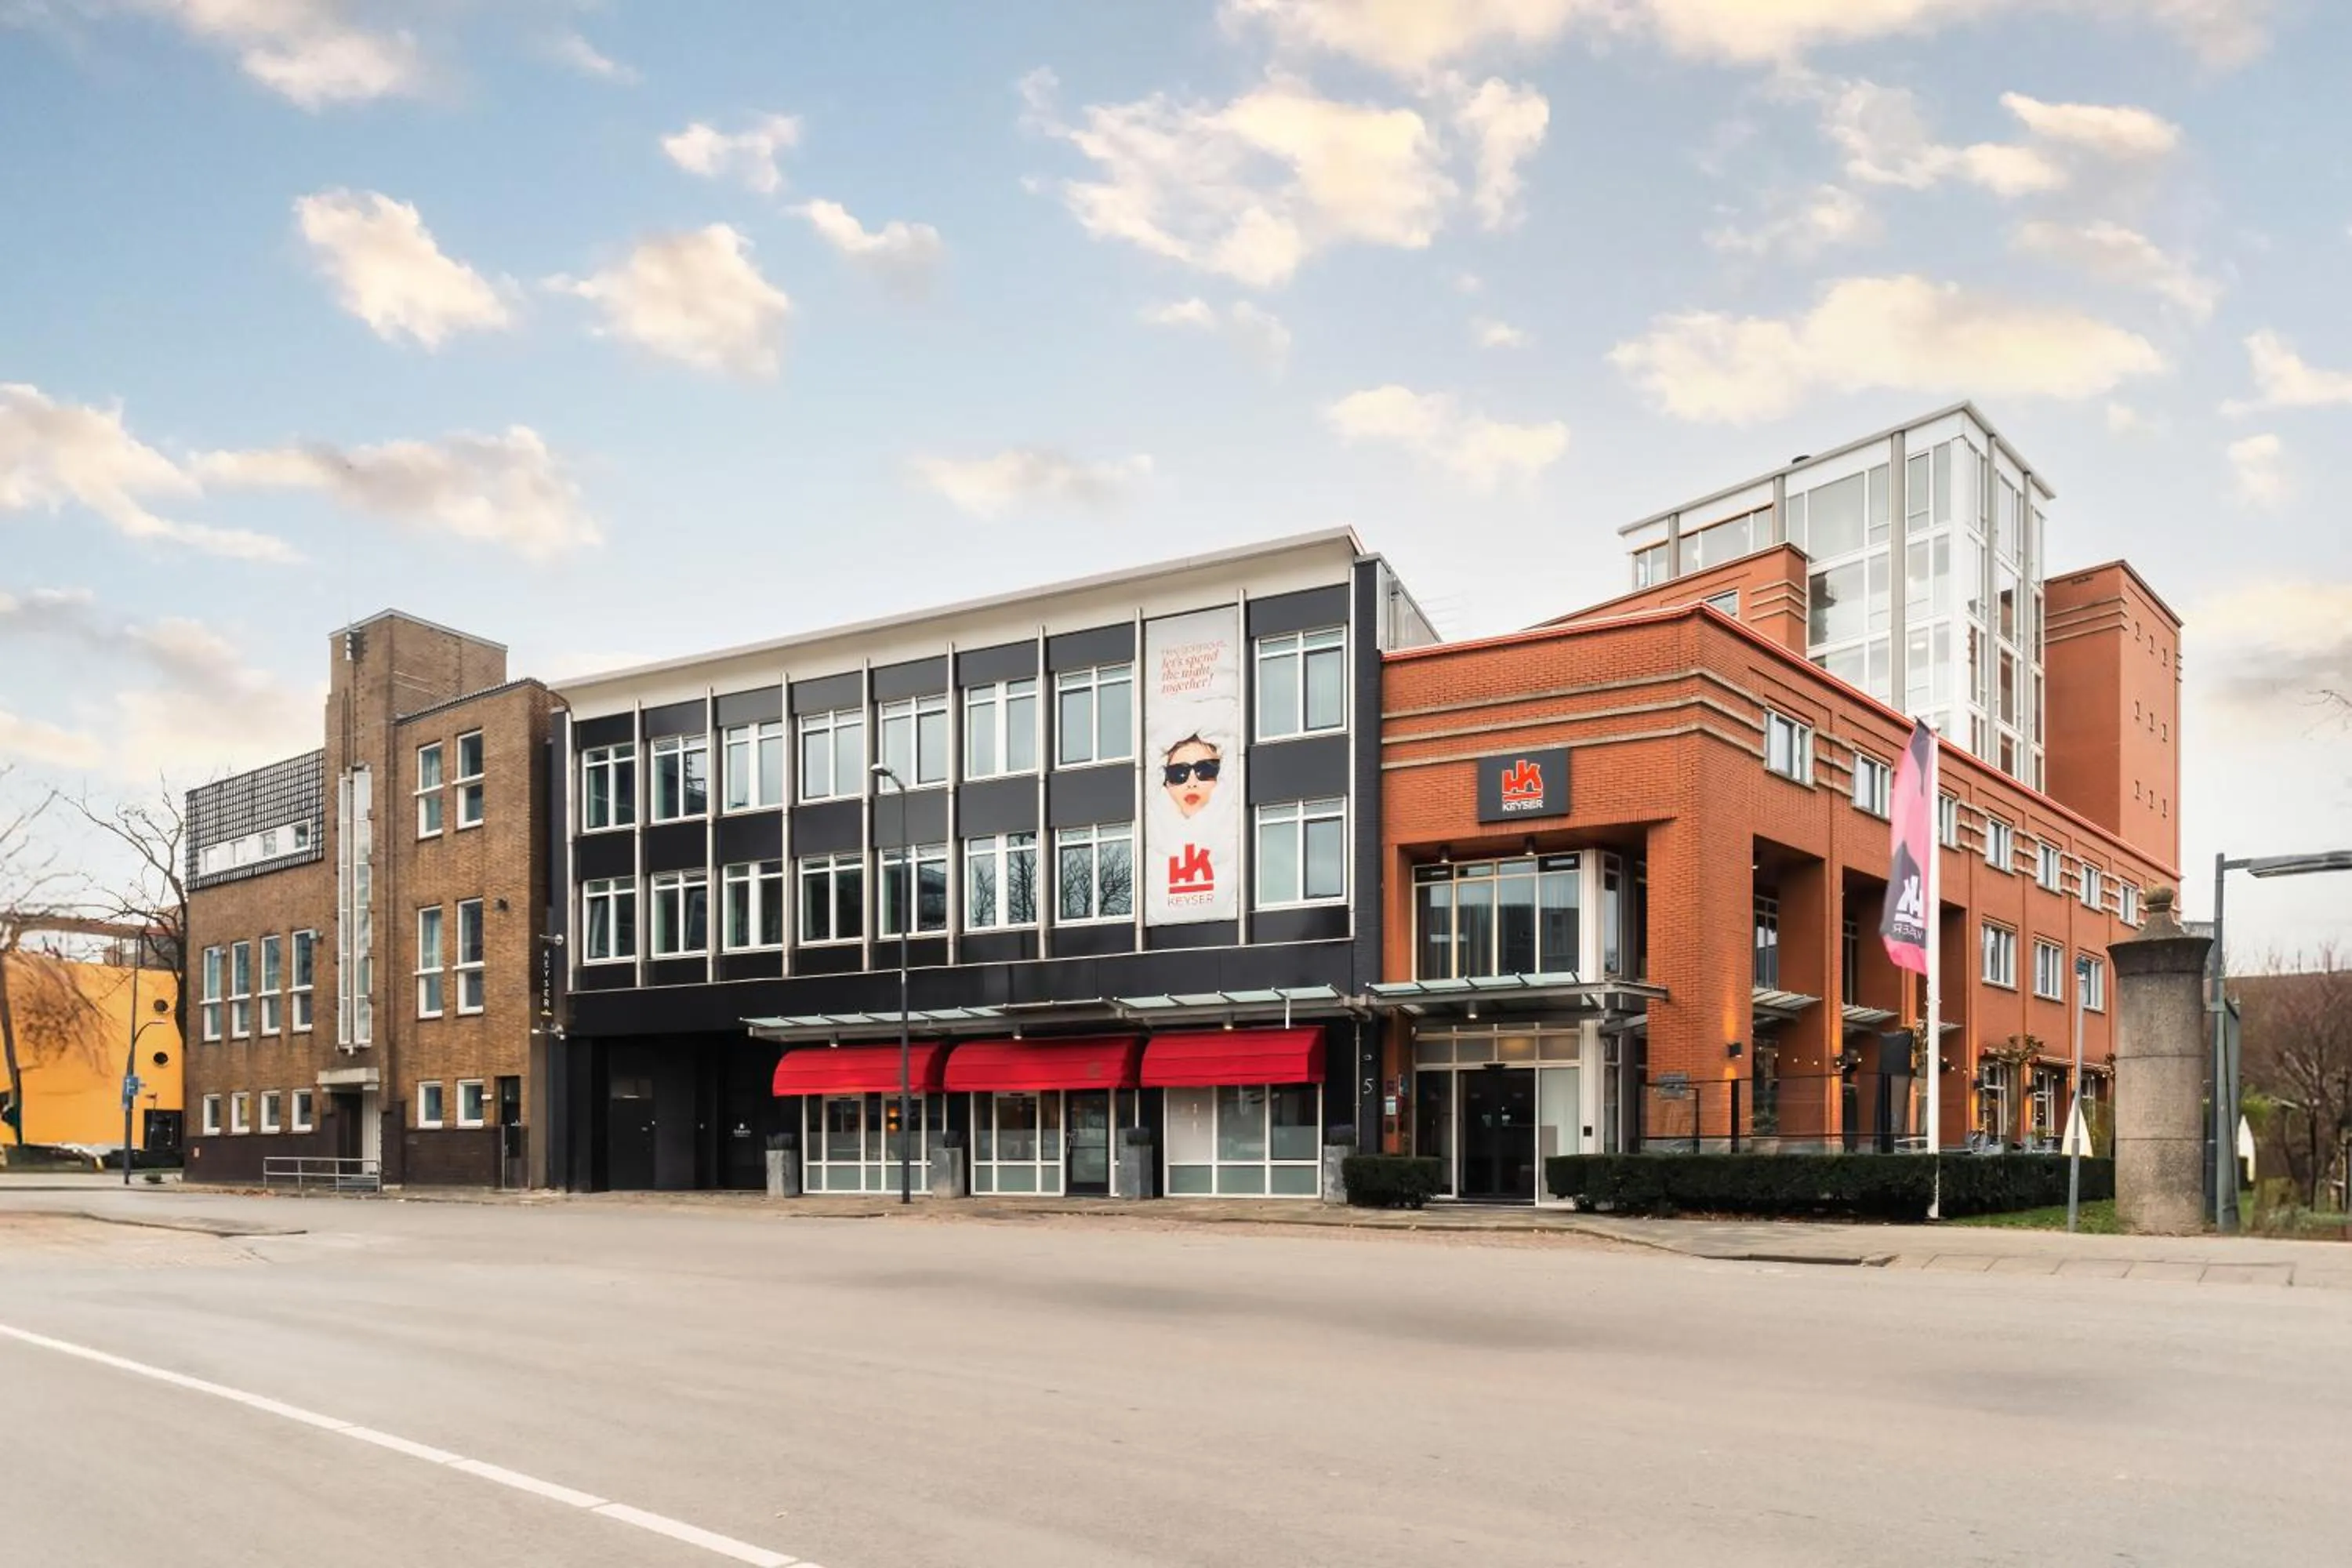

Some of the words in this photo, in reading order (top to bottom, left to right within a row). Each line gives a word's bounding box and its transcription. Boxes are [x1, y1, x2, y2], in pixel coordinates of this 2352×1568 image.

[1502, 800, 1544, 812] KEYSER
[1167, 894, 1214, 906] KEYSER
[1363, 1078, 1374, 1094] 5
